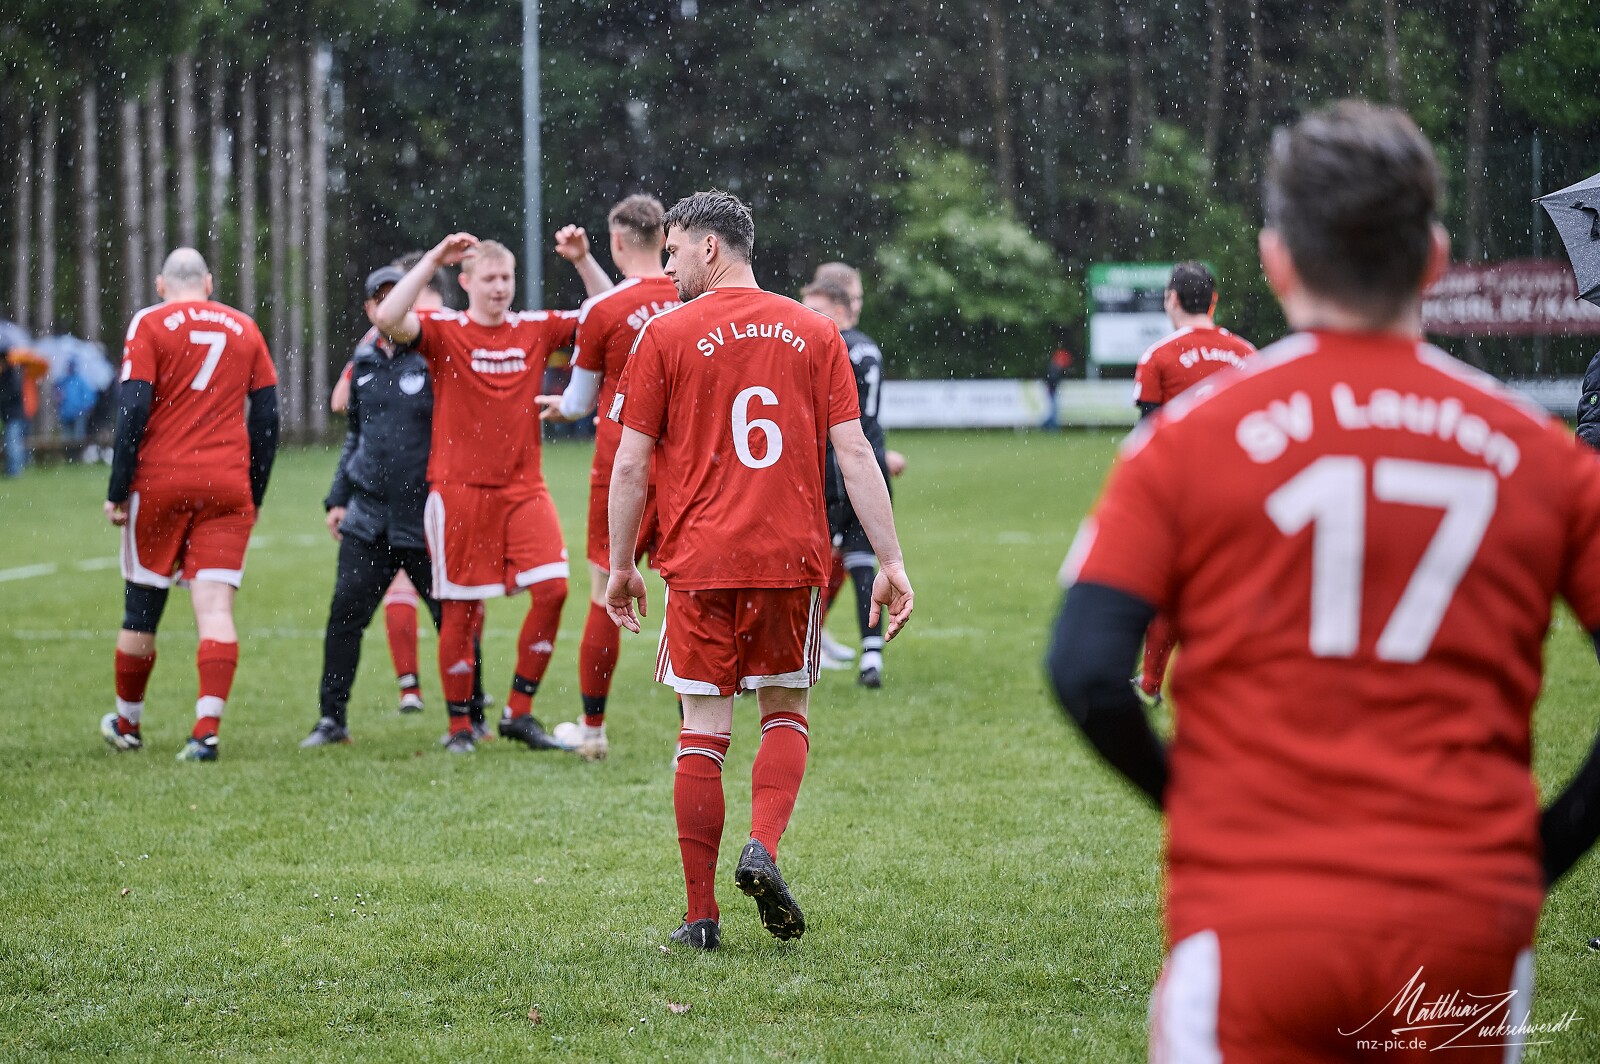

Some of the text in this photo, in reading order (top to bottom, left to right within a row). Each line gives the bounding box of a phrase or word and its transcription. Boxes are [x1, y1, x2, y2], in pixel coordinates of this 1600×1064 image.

[163, 307, 244, 336] SV Laufen
[627, 305, 650, 330] SV
[697, 322, 806, 357] SV Laufen
[189, 330, 227, 391] 7
[731, 386, 783, 469] 6
[1236, 382, 1521, 478] SV Laufen
[1265, 454, 1498, 664] 17
